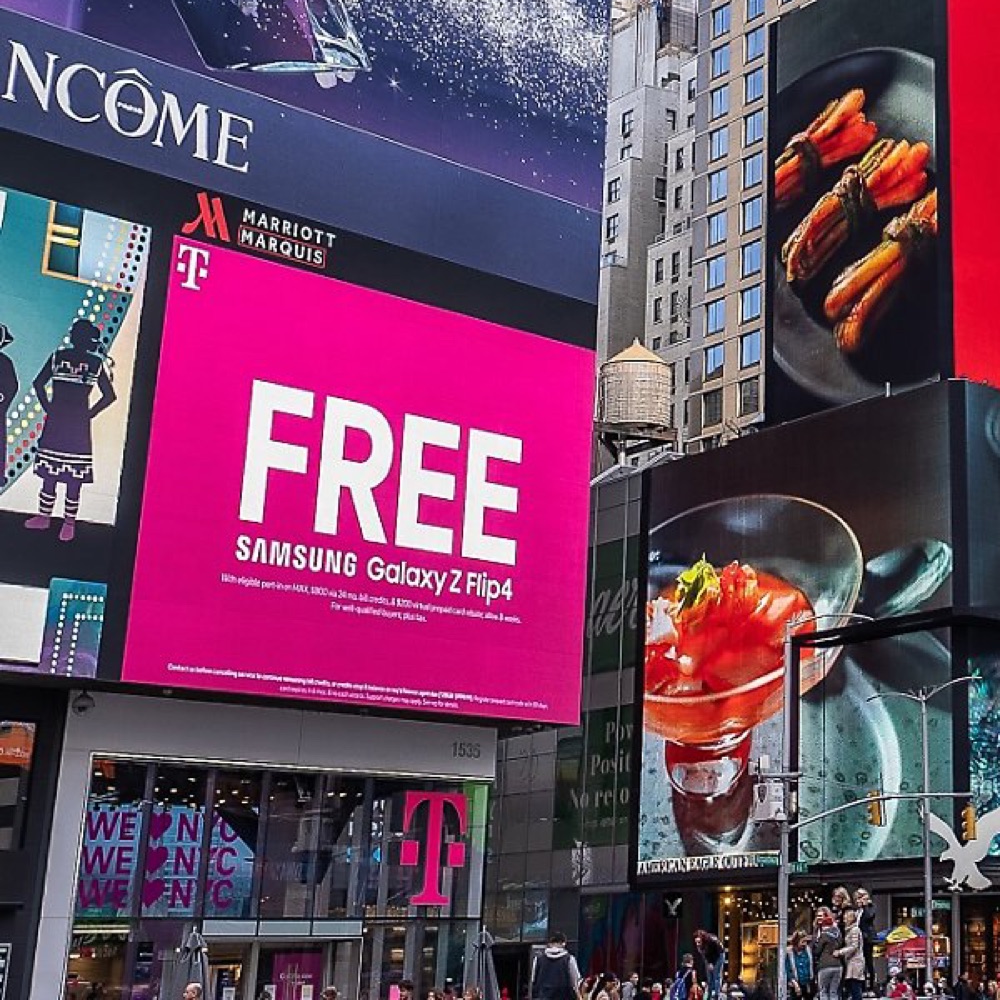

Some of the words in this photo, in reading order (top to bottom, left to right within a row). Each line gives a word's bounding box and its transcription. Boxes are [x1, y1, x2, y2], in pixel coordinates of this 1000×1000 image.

[240, 229, 324, 265] MARQUIS
[242, 208, 337, 248] MARRIOTT
[177, 244, 209, 290] T
[239, 378, 523, 566] FREE
[235, 534, 357, 578] SAMSUNG
[366, 556, 447, 599] Galaxy
[449, 570, 461, 593] Z
[466, 572, 513, 605] Flip4
[452, 741, 481, 759] 1535
[86, 812, 138, 841] WE
[81, 845, 133, 875] WE
[399, 791, 469, 906] T
[79, 878, 129, 910] WE
